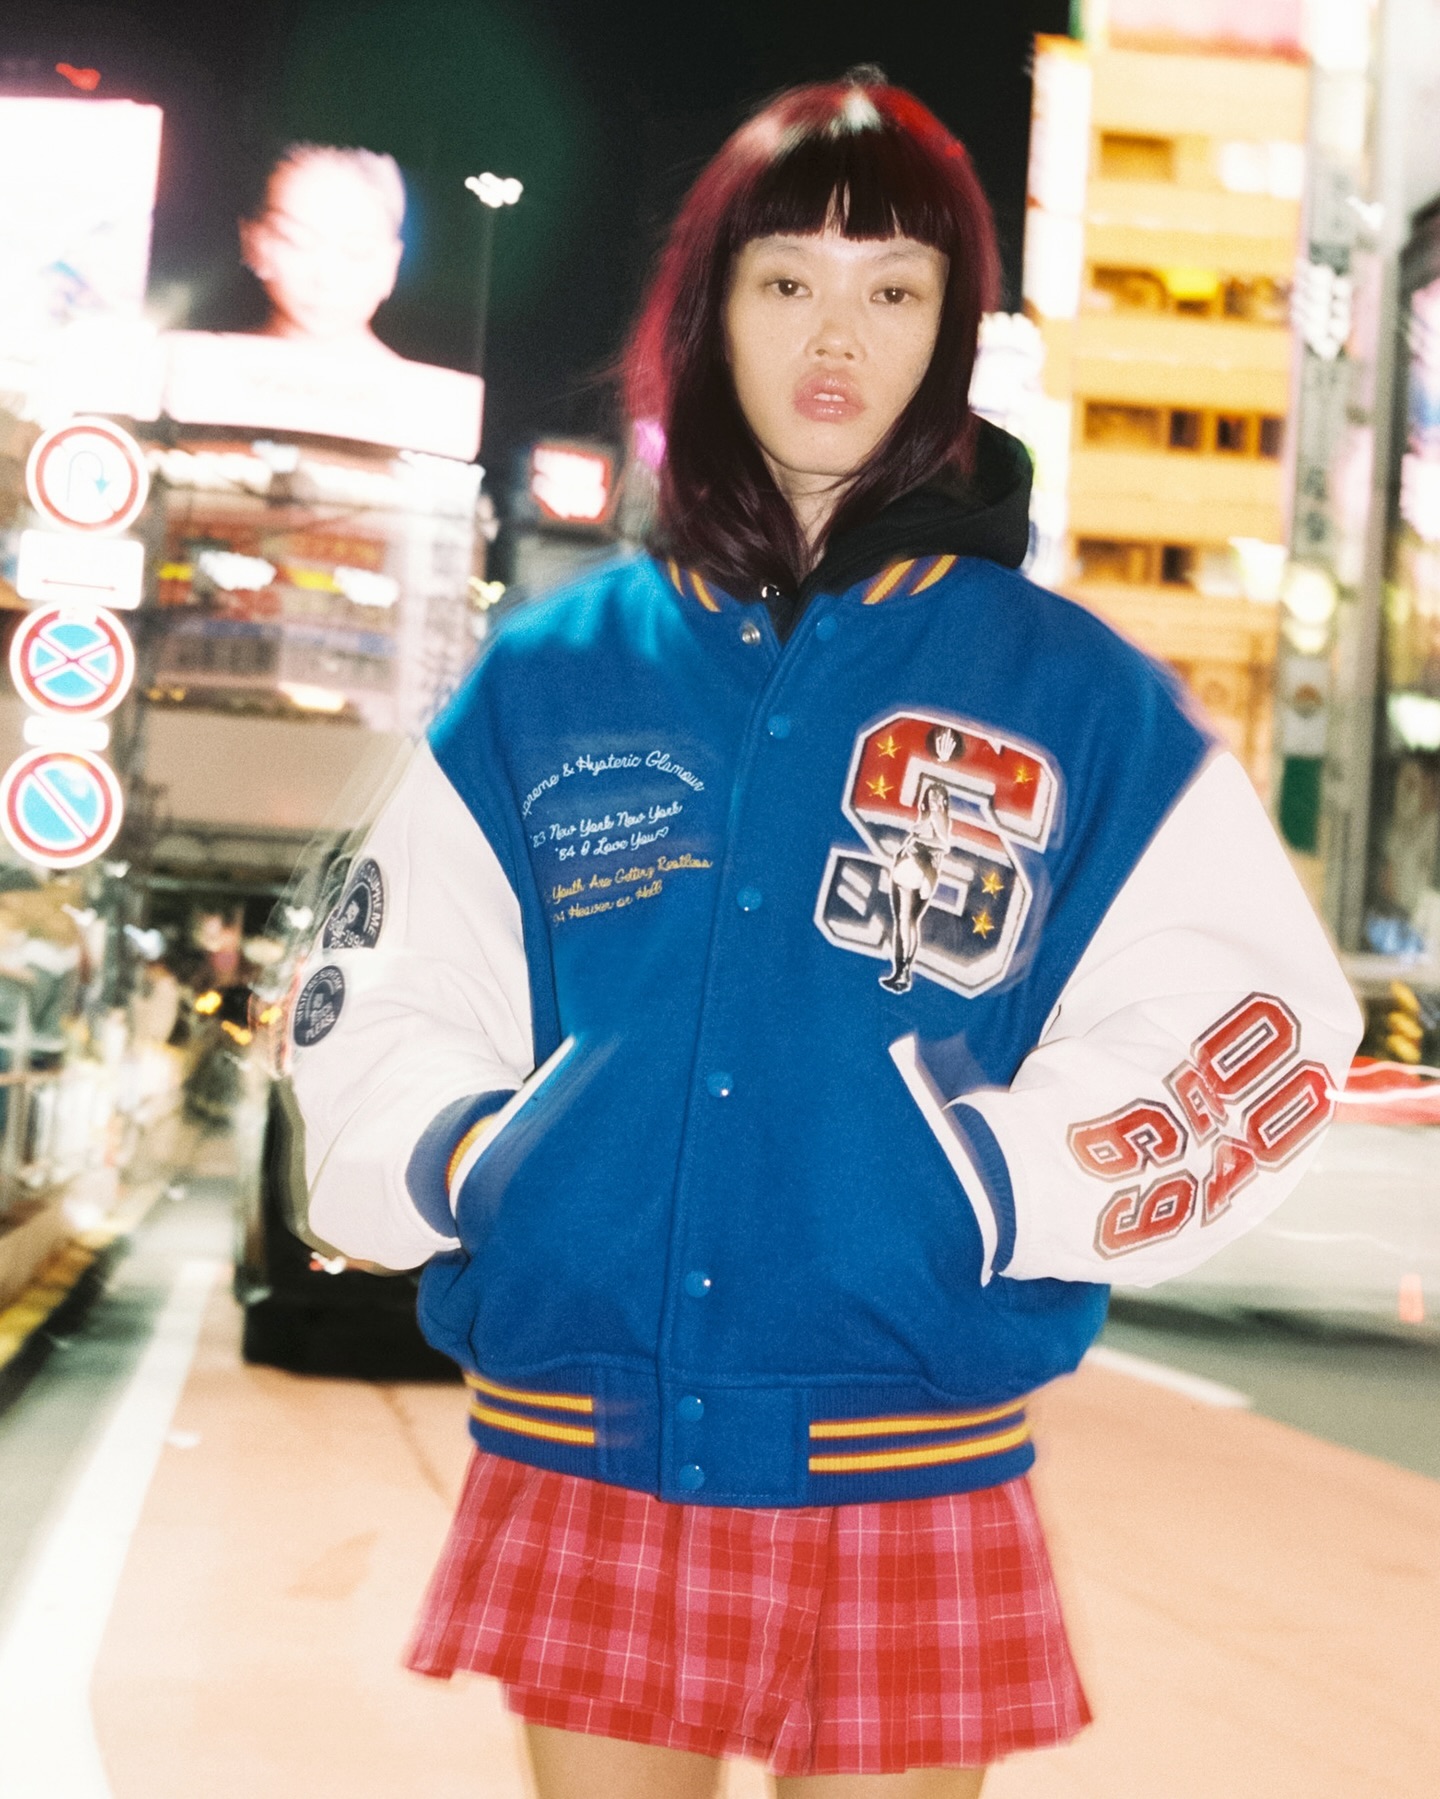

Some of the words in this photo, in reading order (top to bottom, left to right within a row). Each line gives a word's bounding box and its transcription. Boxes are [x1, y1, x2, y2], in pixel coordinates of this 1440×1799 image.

[562, 762, 575, 778] &
[575, 753, 642, 777] Hysteric
[645, 750, 705, 792] Glamour
[549, 823, 577, 841] New
[580, 815, 614, 838] York
[616, 811, 646, 828] New
[648, 800, 683, 825] York
[555, 845, 576, 861] '84
[593, 836, 629, 856] Love
[630, 831, 657, 851] You
[552, 877, 586, 905] Youth
[589, 873, 613, 890] Are
[614, 867, 656, 884] Getting
[657, 853, 714, 872] Restless
[568, 902, 614, 921] Heaven
[634, 879, 663, 901] Hell
